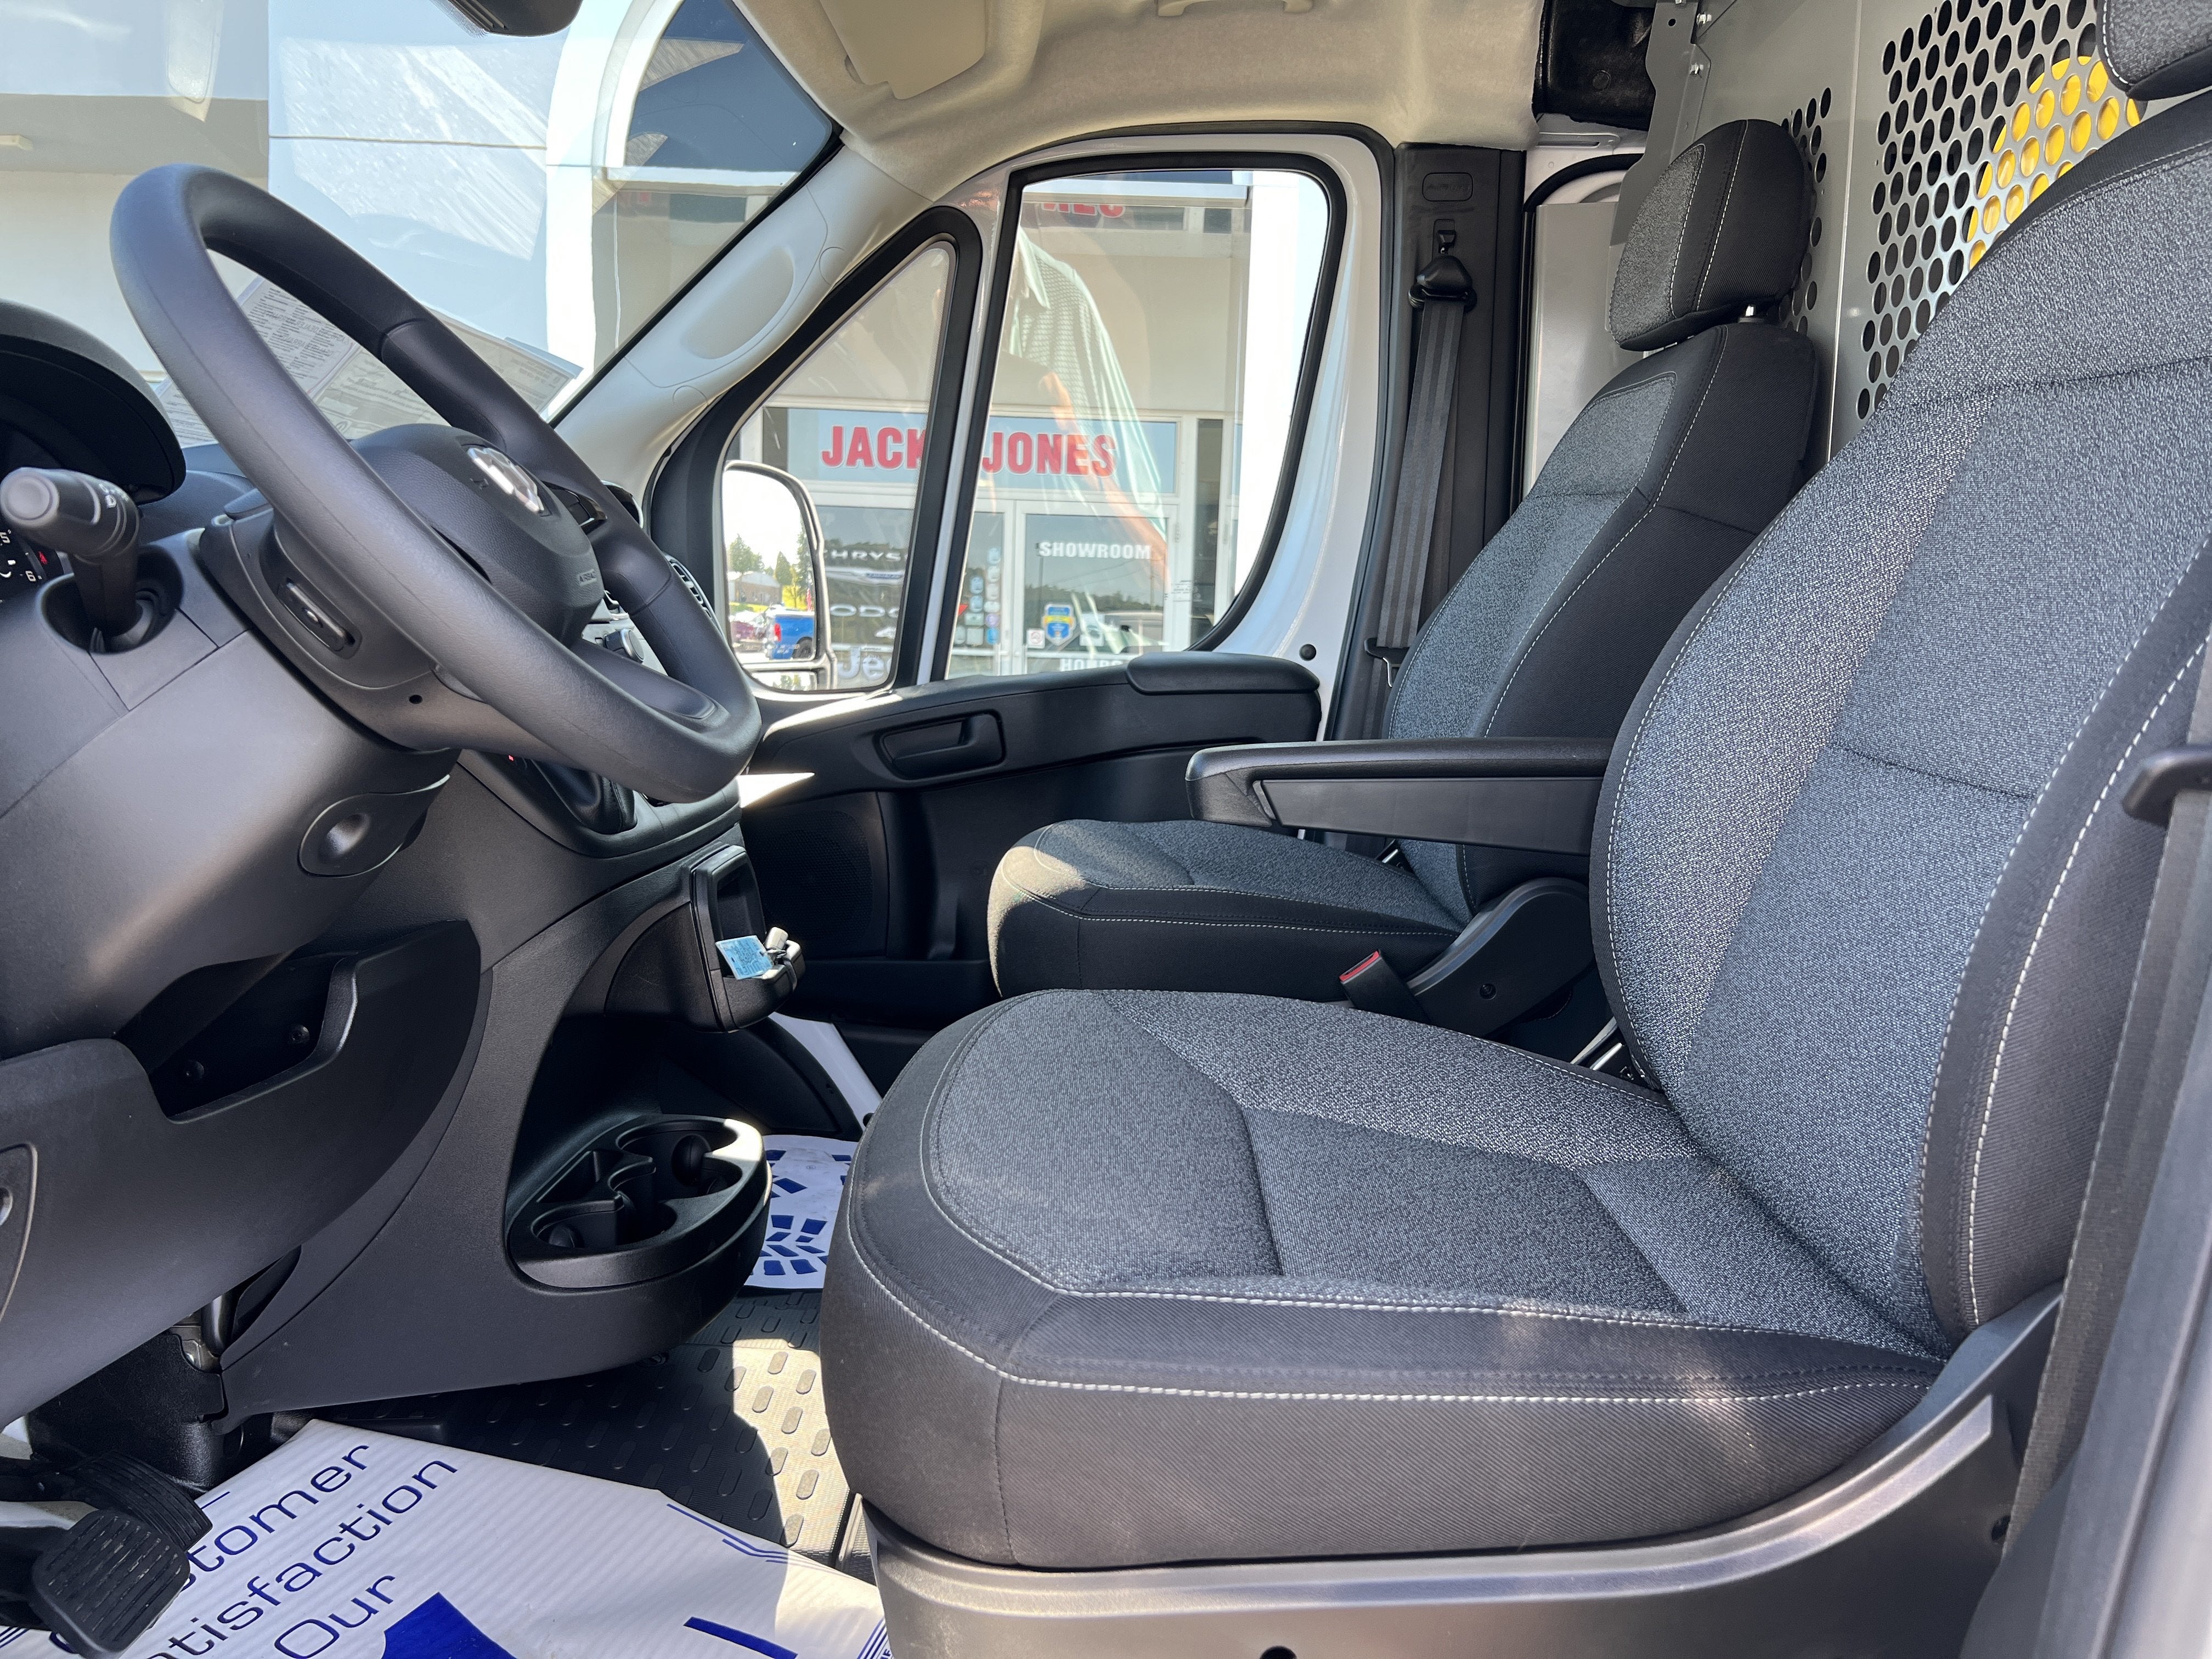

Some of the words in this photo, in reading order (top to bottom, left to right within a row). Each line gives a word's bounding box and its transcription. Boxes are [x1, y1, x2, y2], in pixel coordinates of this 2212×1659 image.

[820, 426, 926, 470] JACK
[981, 431, 1117, 477] JONES
[823, 549, 908, 562] HRYS
[1039, 541, 1152, 560] SHOWROOM
[25, 571, 36, 582] 6
[146, 1460, 459, 1659] tisfaction
[274, 1575, 396, 1659] Our
